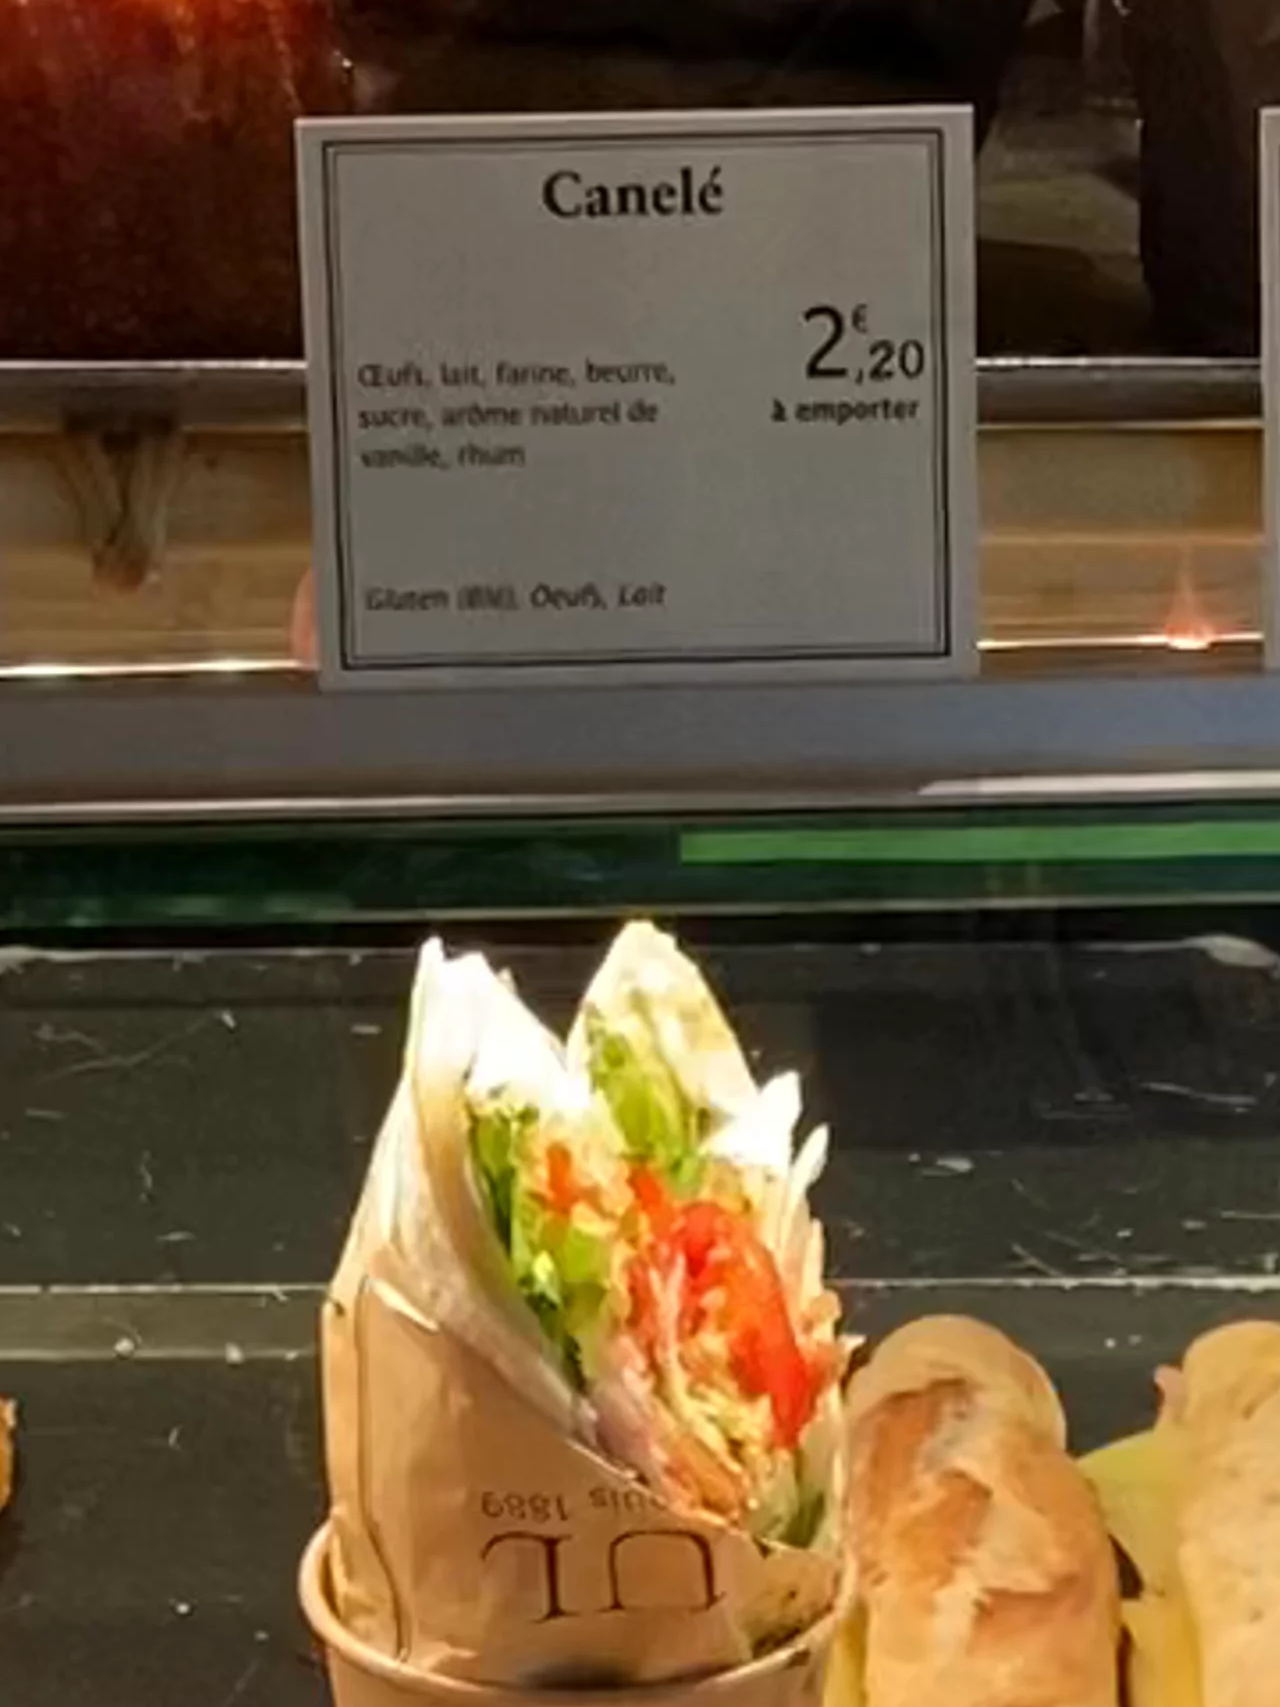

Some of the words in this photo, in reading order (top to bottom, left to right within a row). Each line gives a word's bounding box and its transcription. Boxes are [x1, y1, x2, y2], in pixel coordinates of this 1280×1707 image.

[541, 166, 725, 218] Canelé
[495, 360, 576, 388] farine,
[584, 356, 676, 386] beurre,
[357, 406, 434, 432] sucre,
[441, 400, 522, 427] arôme
[530, 399, 622, 426] naturel
[626, 397, 660, 424] de
[771, 399, 787, 423] à
[794, 399, 920, 427] emporter
[457, 442, 526, 468] rhum
[480, 1491, 570, 1524] 1889
